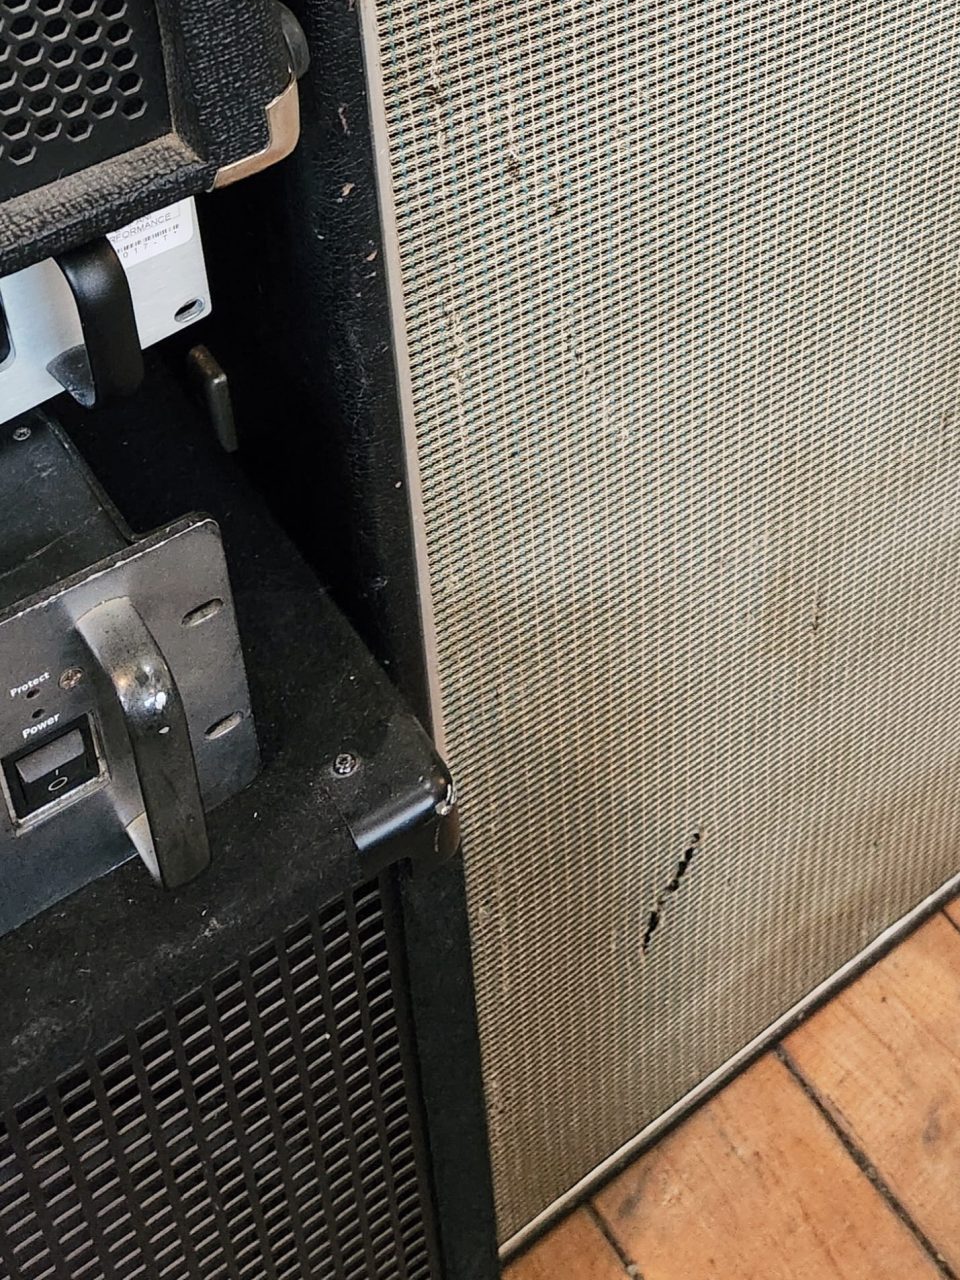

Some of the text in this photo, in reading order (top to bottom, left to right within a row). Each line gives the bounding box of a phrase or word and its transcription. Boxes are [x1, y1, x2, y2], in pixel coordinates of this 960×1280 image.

[109, 213, 172, 242] RFORMANCE
[10, 672, 51, 698] Protect
[22, 712, 60, 739] Power
